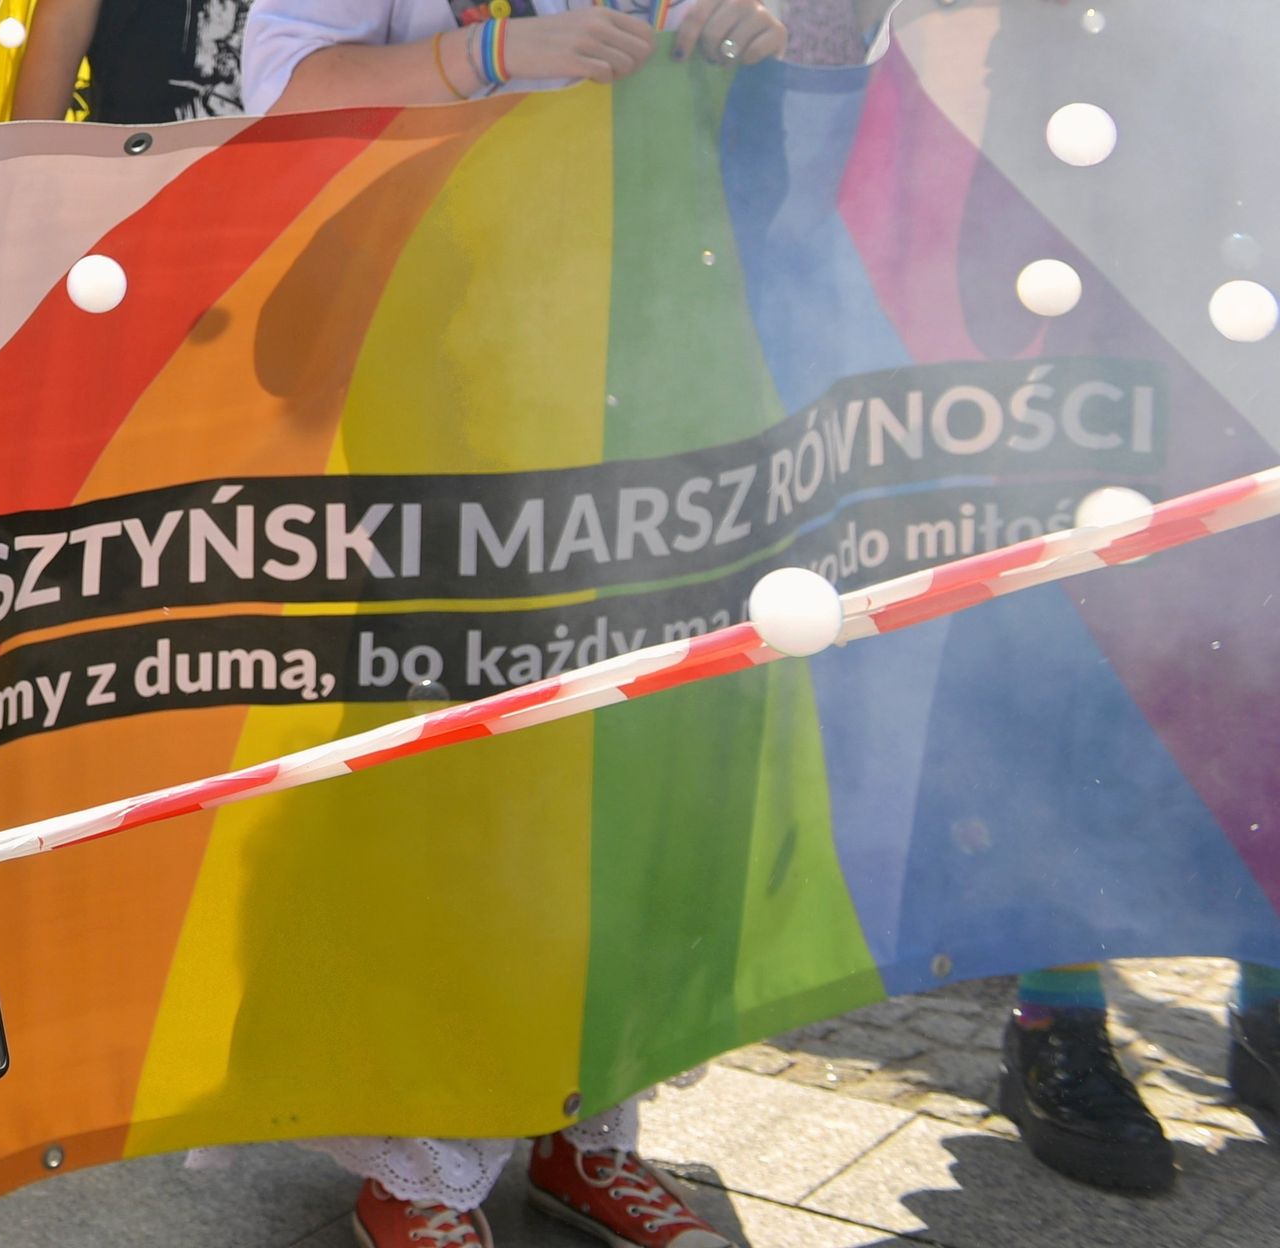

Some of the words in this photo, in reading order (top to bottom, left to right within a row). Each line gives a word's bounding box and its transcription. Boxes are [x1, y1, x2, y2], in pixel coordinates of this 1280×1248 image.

[459, 463, 757, 576] MARSZ
[766, 364, 1154, 525] RÓWNOŚCI
[86, 662, 116, 707] z
[135, 638, 337, 701] dumą,
[359, 632, 443, 688] bo
[906, 497, 1077, 563] miłoś
